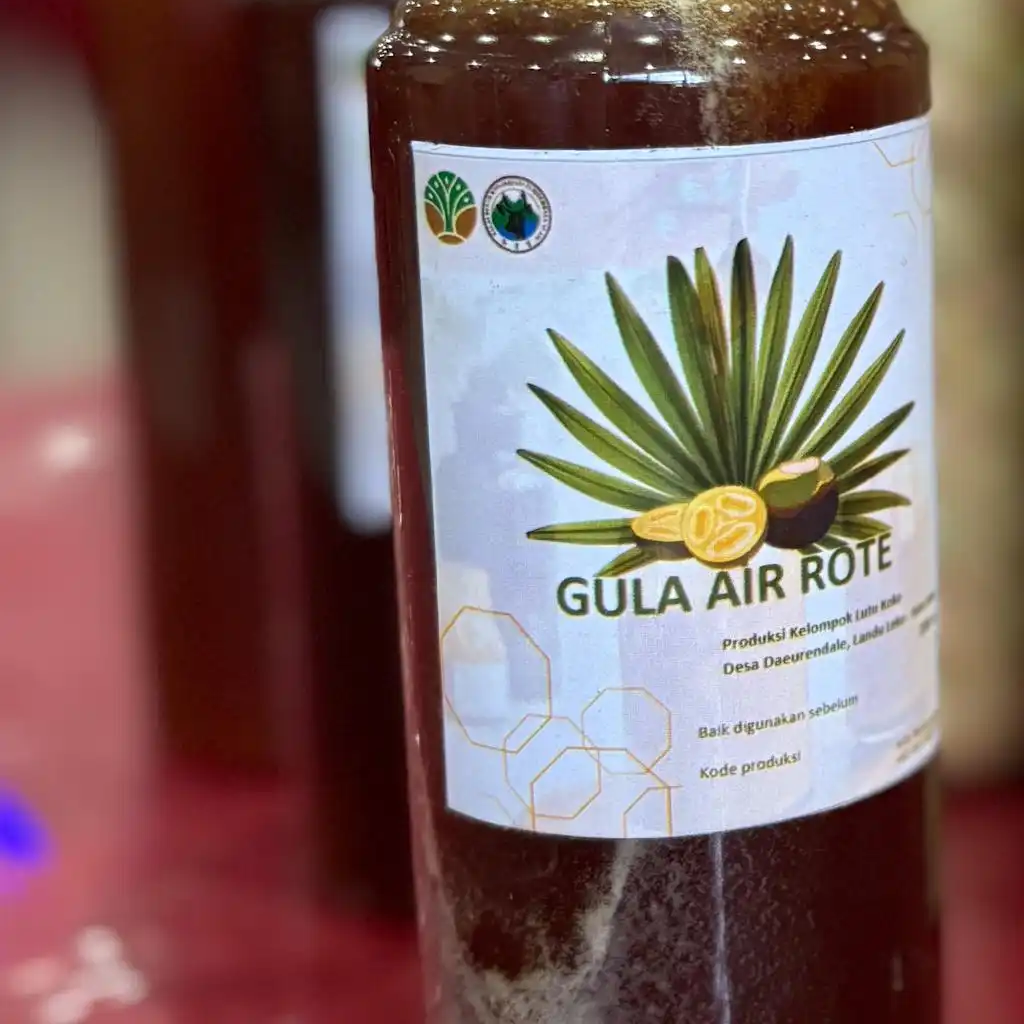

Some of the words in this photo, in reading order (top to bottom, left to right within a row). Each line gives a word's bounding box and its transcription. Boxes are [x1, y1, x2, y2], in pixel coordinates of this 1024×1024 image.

[556, 576, 692, 617] GULA
[706, 563, 786, 610] AIR
[800, 533, 893, 595] ROTE
[722, 627, 787, 651] Produksi
[790, 612, 853, 639] Kelompok
[723, 659, 760, 676] Desa
[763, 639, 852, 670] Daeurendale,
[852, 624, 885, 645] Landu
[698, 722, 730, 739] Baik
[733, 709, 806, 735] digunakan
[808, 693, 860, 719] sebelum
[699, 760, 738, 779] Kode
[741, 750, 802, 776] produksi
